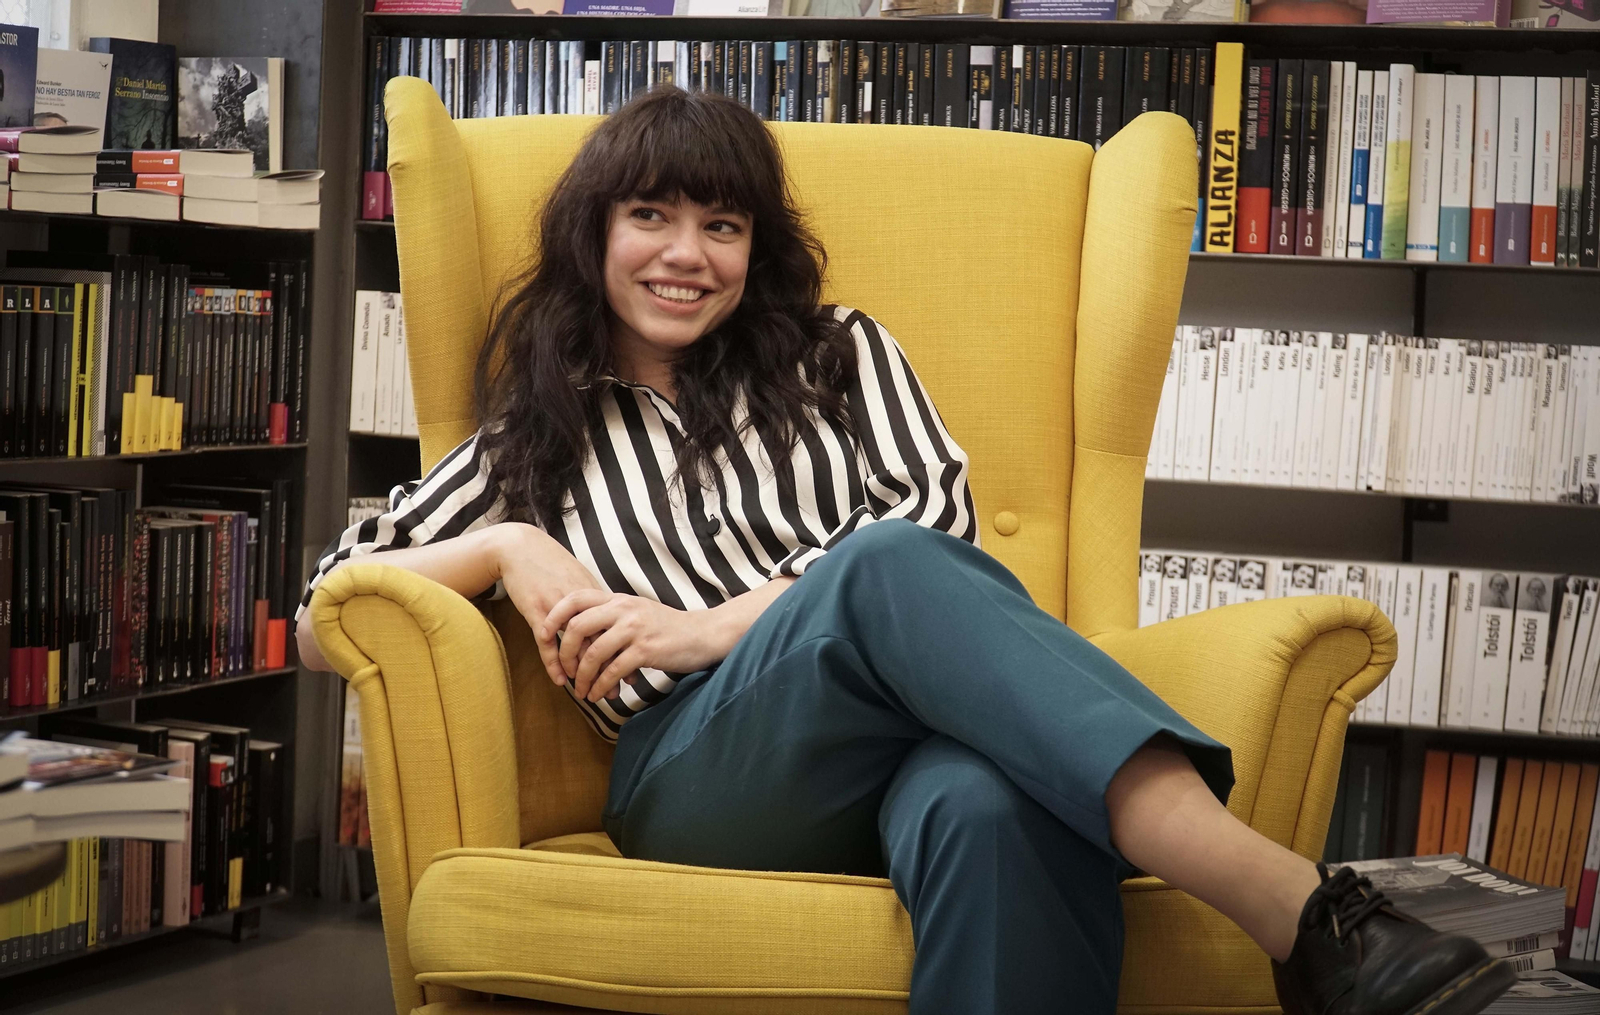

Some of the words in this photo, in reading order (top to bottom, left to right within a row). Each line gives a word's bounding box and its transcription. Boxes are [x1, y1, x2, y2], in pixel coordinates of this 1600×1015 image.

[123, 77, 145, 89] Daniel
[145, 78, 167, 91] Martín
[1249, 66, 1260, 84] COMO
[36, 86, 44, 94] NO
[45, 87, 57, 95] HAY
[57, 88, 75, 97] BESTIA
[76, 90, 86, 98] TAN
[86, 91, 101, 99] FEROZ
[114, 87, 141, 99] Serrano
[141, 91, 169, 102] Insomnio
[1590, 83, 1600, 116] Maalouf
[1562, 104, 1571, 137] Blanchard
[1574, 104, 1583, 138] Blanchard
[1589, 118, 1599, 140] Amín
[1245, 121, 1258, 150] PRINCIPIO
[1561, 139, 1569, 160] María
[1574, 139, 1582, 161] María
[1282, 154, 1291, 182] MUNDOS
[1307, 154, 1316, 183] MUNDOS
[1209, 129, 1235, 246] ALIANZA
[1558, 188, 1568, 210] Magro
[1571, 188, 1580, 210] Magro
[1281, 188, 1290, 214] GUERRA
[1306, 189, 1315, 216] GUERRA
[1558, 211, 1566, 236] Baltasar
[1570, 211, 1578, 237] Baltasar
[43, 298, 51, 308] A
[362, 302, 370, 330] Comedia
[361, 330, 369, 351] Divina
[1201, 355, 1210, 381] Hesse
[1220, 348, 1230, 377] London
[1261, 350, 1270, 371] Kafka
[1277, 352, 1286, 371] Kafka
[1291, 349, 1299, 368] Kafka
[1332, 354, 1343, 378] Kipling
[1384, 351, 1392, 376] London
[1414, 355, 1422, 379] London
[1467, 362, 1477, 394] Maalouf
[1484, 363, 1494, 395] Maalouf
[1542, 365, 1553, 408] Maupassant
[1558, 362, 1567, 392] Unamuno
[1586, 454, 1597, 479] Woolf
[1146, 580, 1156, 607] Proust
[1166, 586, 1179, 620] Proust
[1193, 583, 1202, 609] Proust
[4, 599, 12, 626] Terral
[1563, 599, 1574, 621] Twain
[1483, 614, 1501, 659] Tolstói
[1519, 618, 1538, 662] Tolstói
[1412, 858, 1482, 875] JOT
